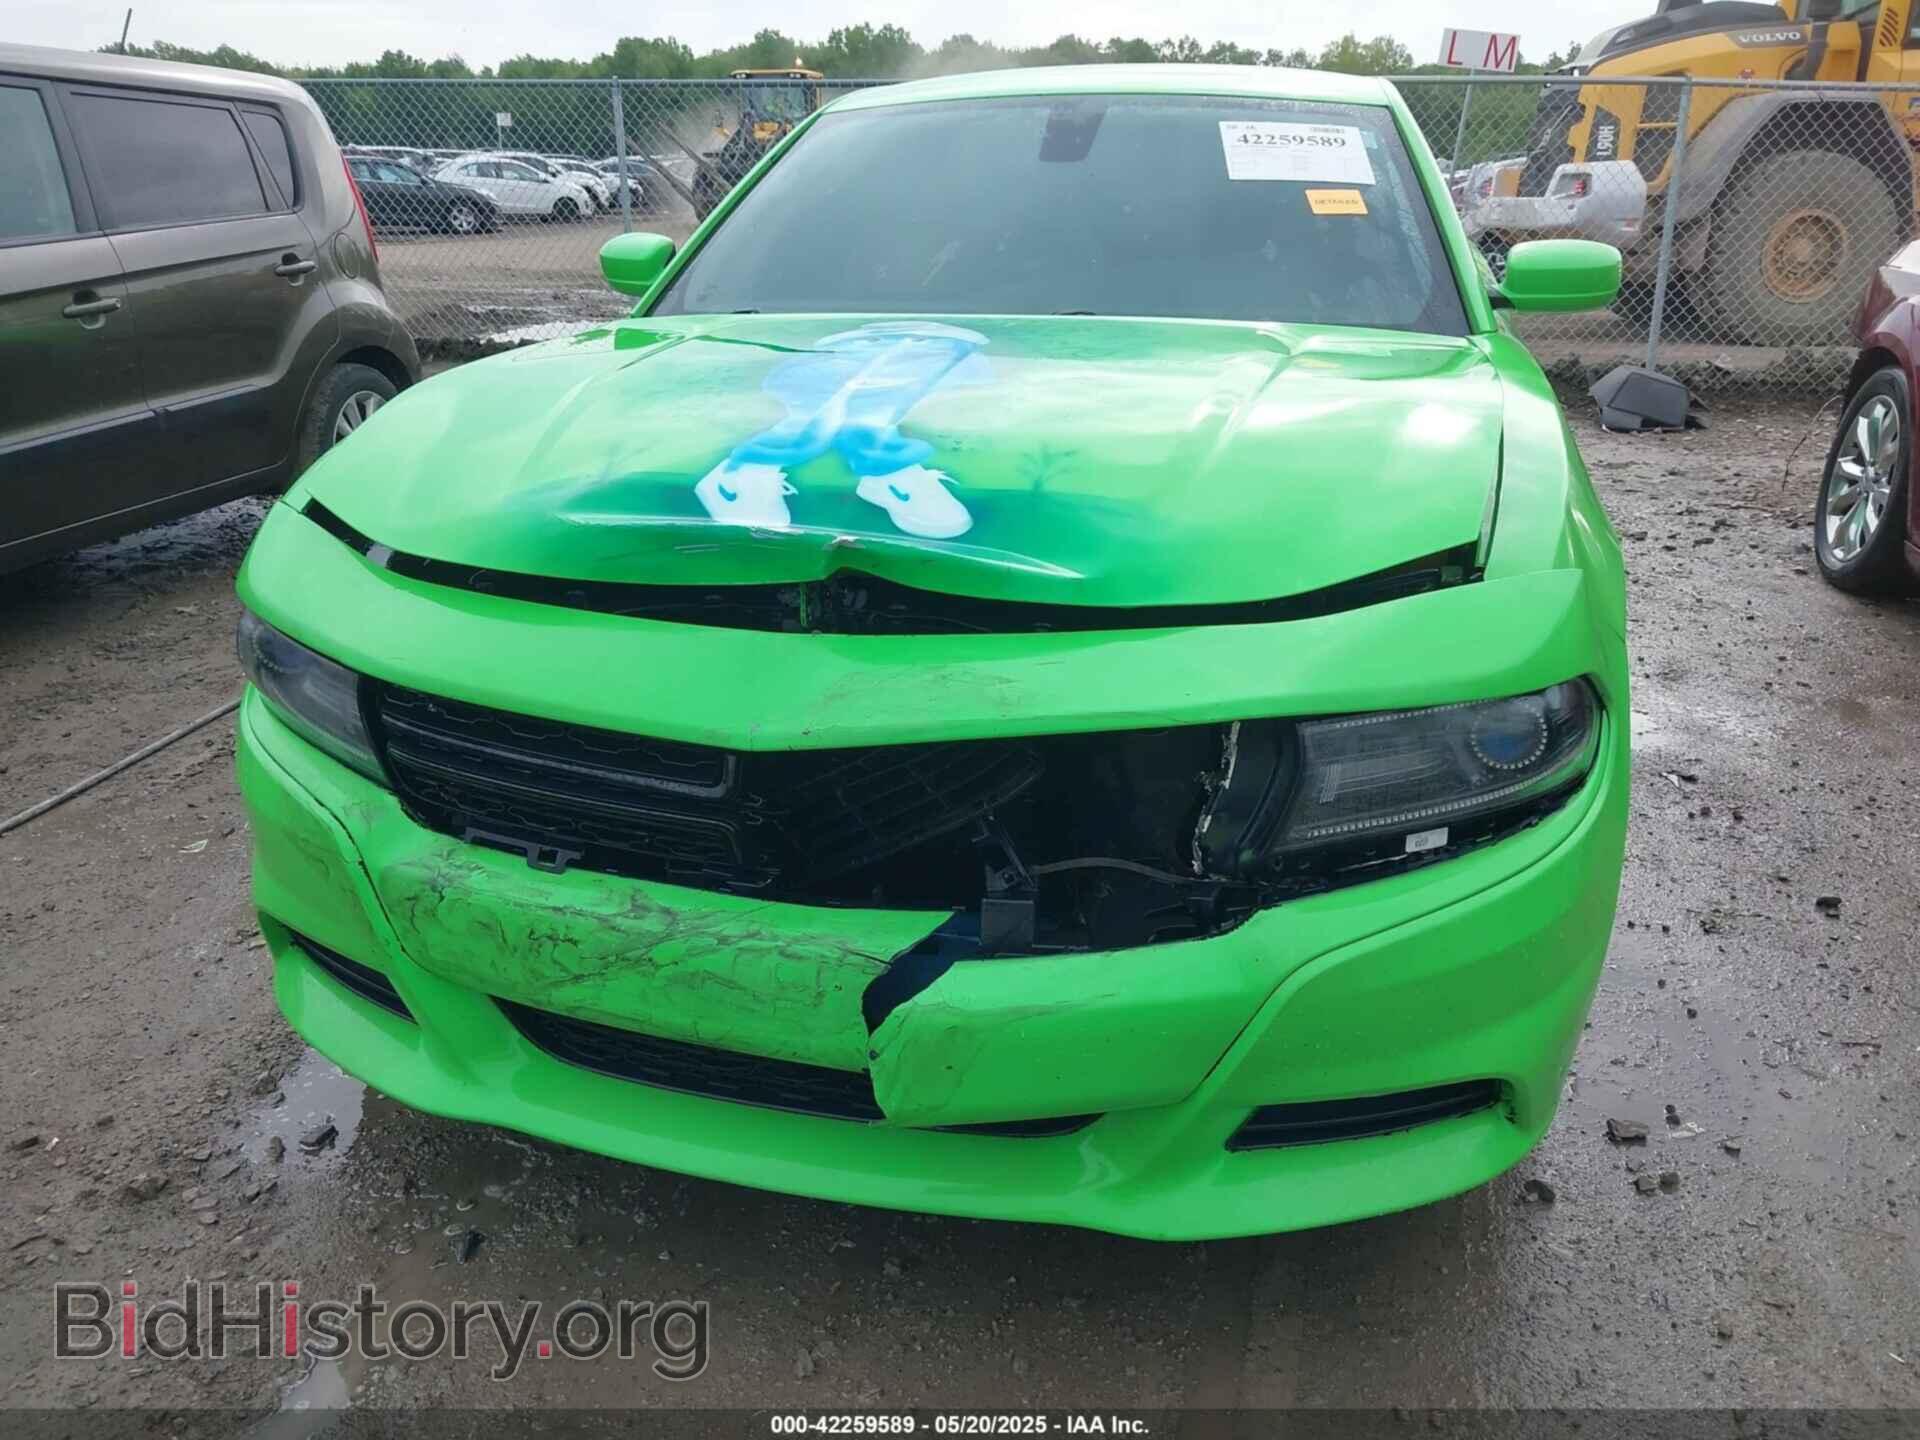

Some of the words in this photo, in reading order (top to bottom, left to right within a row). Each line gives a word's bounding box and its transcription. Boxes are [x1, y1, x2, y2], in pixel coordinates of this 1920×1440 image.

[1739, 31, 1801, 42] VOLVO
[1447, 30, 1463, 66] L
[1483, 34, 1517, 71] M
[1236, 133, 1346, 148] 42259589
[1596, 125, 1616, 156] L90H
